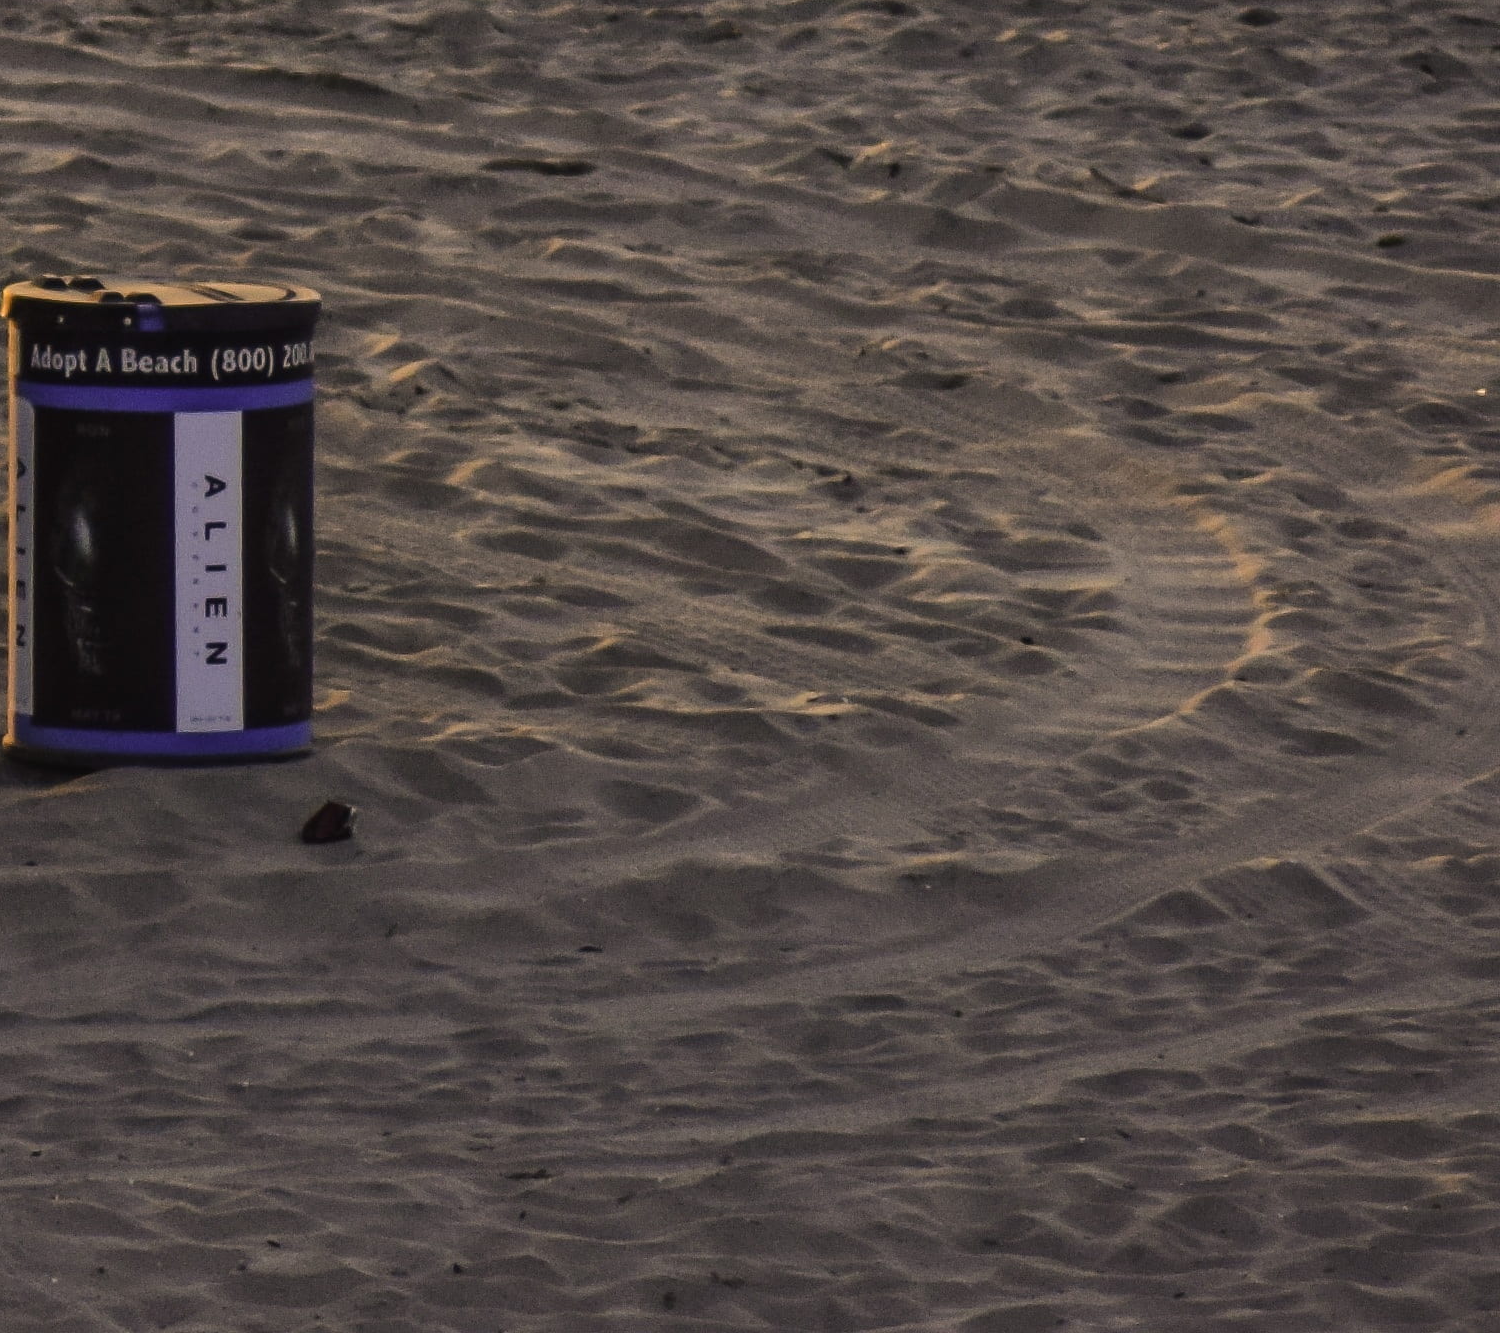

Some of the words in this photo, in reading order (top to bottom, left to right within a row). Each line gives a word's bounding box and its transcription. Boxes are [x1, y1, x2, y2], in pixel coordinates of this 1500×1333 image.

[30, 343, 86, 378] Adopt
[95, 348, 112, 373] A
[120, 348, 198, 374] Beach
[211, 345, 275, 381] (800)
[204, 475, 228, 665] ALIEN
